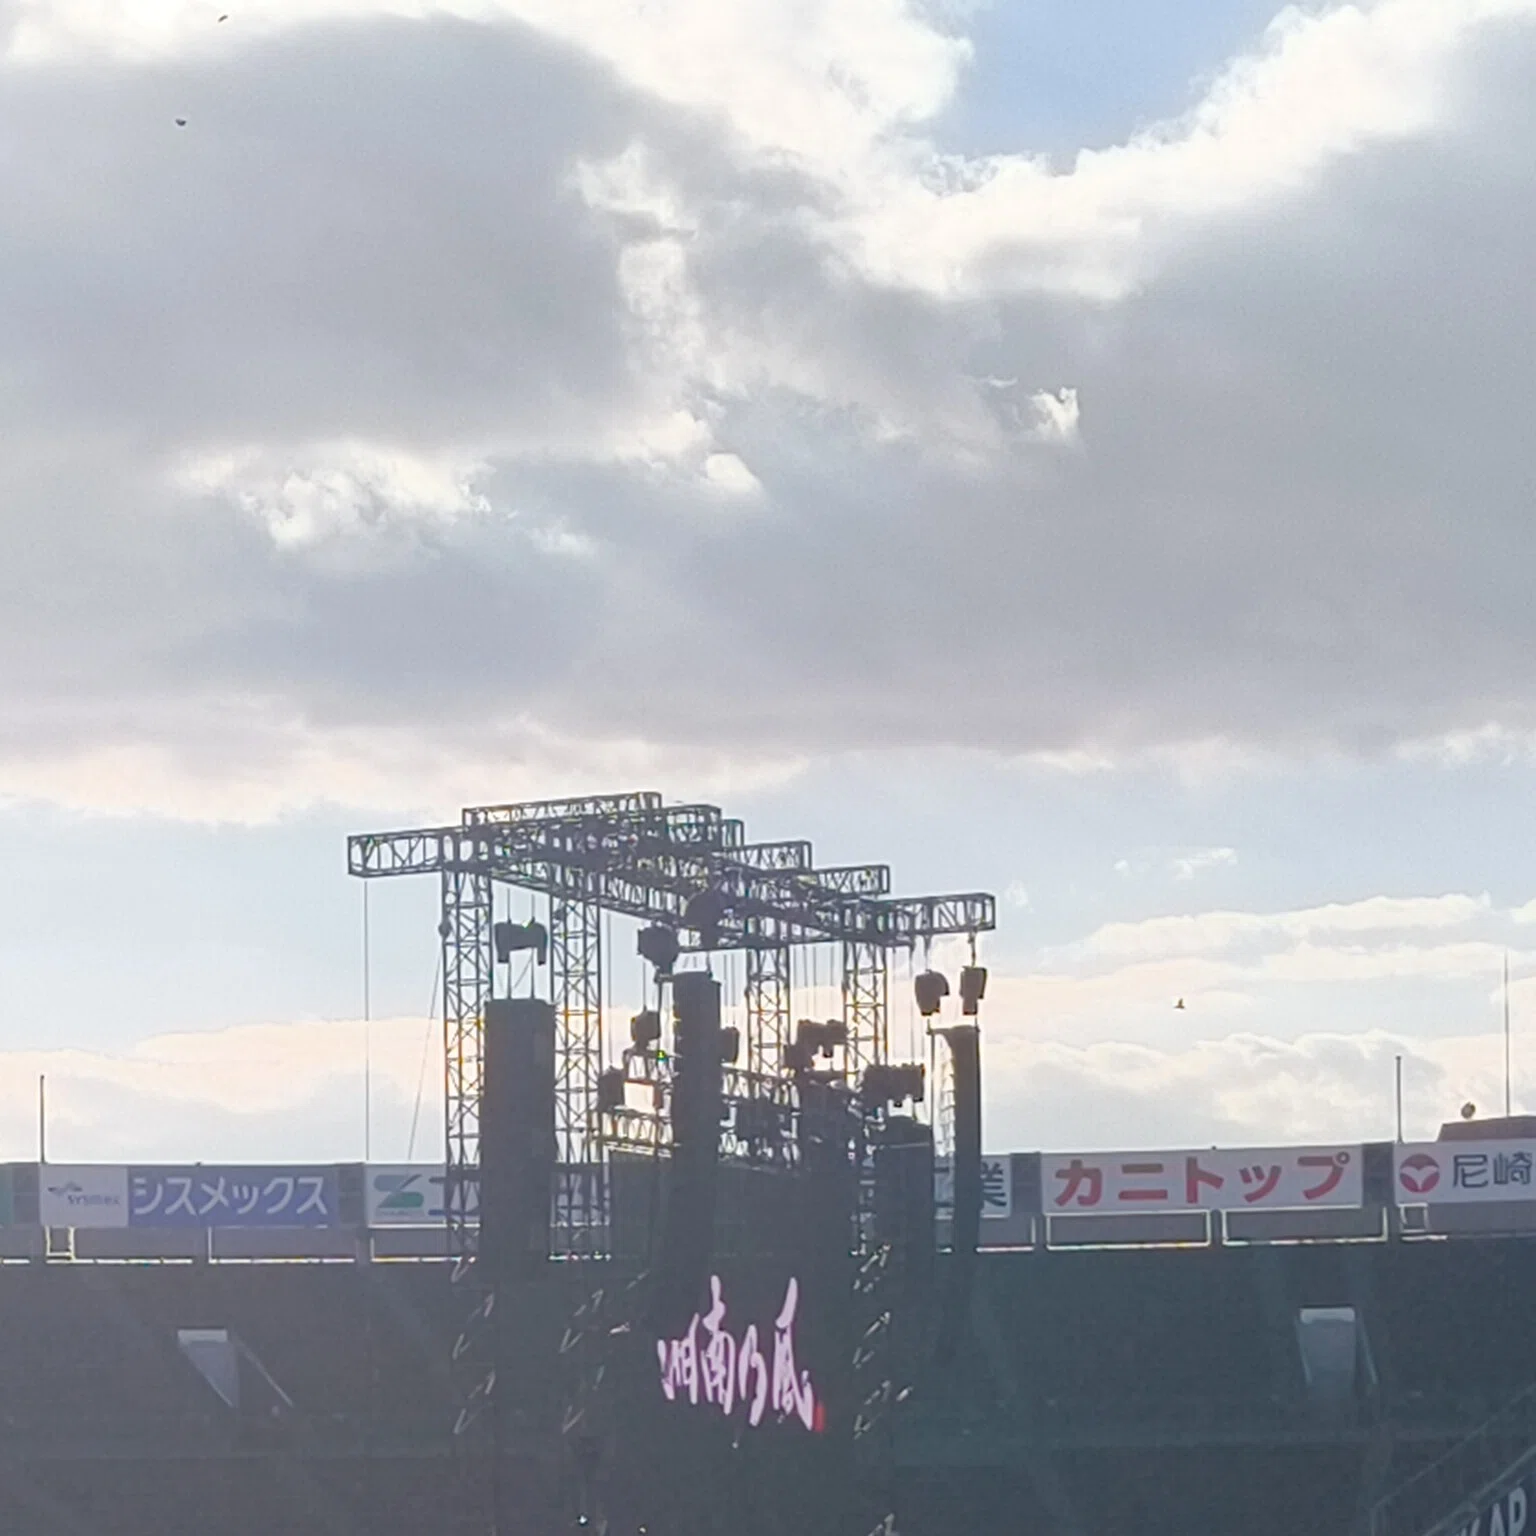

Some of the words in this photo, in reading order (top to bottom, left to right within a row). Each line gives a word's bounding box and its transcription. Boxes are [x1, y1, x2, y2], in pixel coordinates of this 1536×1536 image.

[1054, 1151, 1350, 1207] カニトップ
[1452, 1152, 1533, 1189] 尼崎
[133, 1176, 328, 1216] シスメックス
[656, 1275, 814, 1431] 湘南乃風
